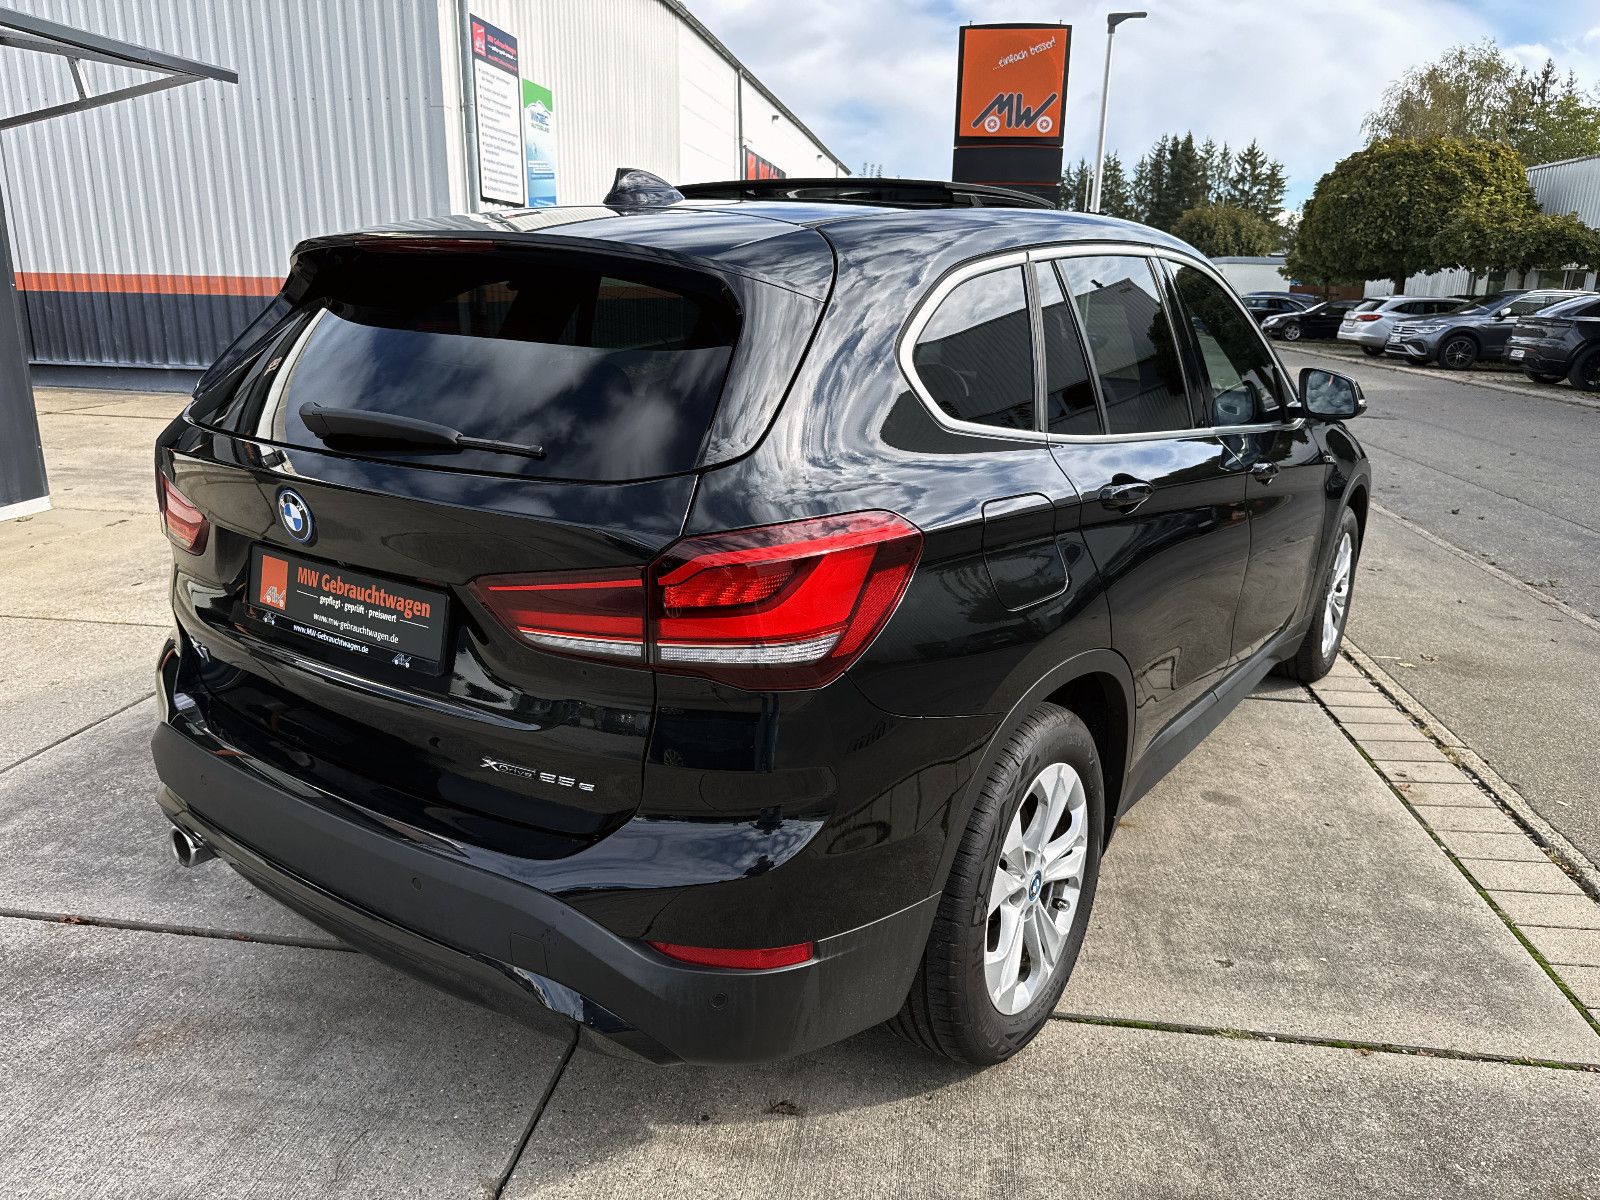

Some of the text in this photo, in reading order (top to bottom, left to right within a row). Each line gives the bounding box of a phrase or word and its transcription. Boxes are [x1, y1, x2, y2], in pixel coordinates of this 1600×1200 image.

[971, 91, 1059, 131] MW
[297, 566, 431, 619] MW Gebrauchtwagen
[319, 595, 397, 623] gepflegt geprüft preiswert
[313, 613, 399, 644] www.mw-gebrauchtwagen.de
